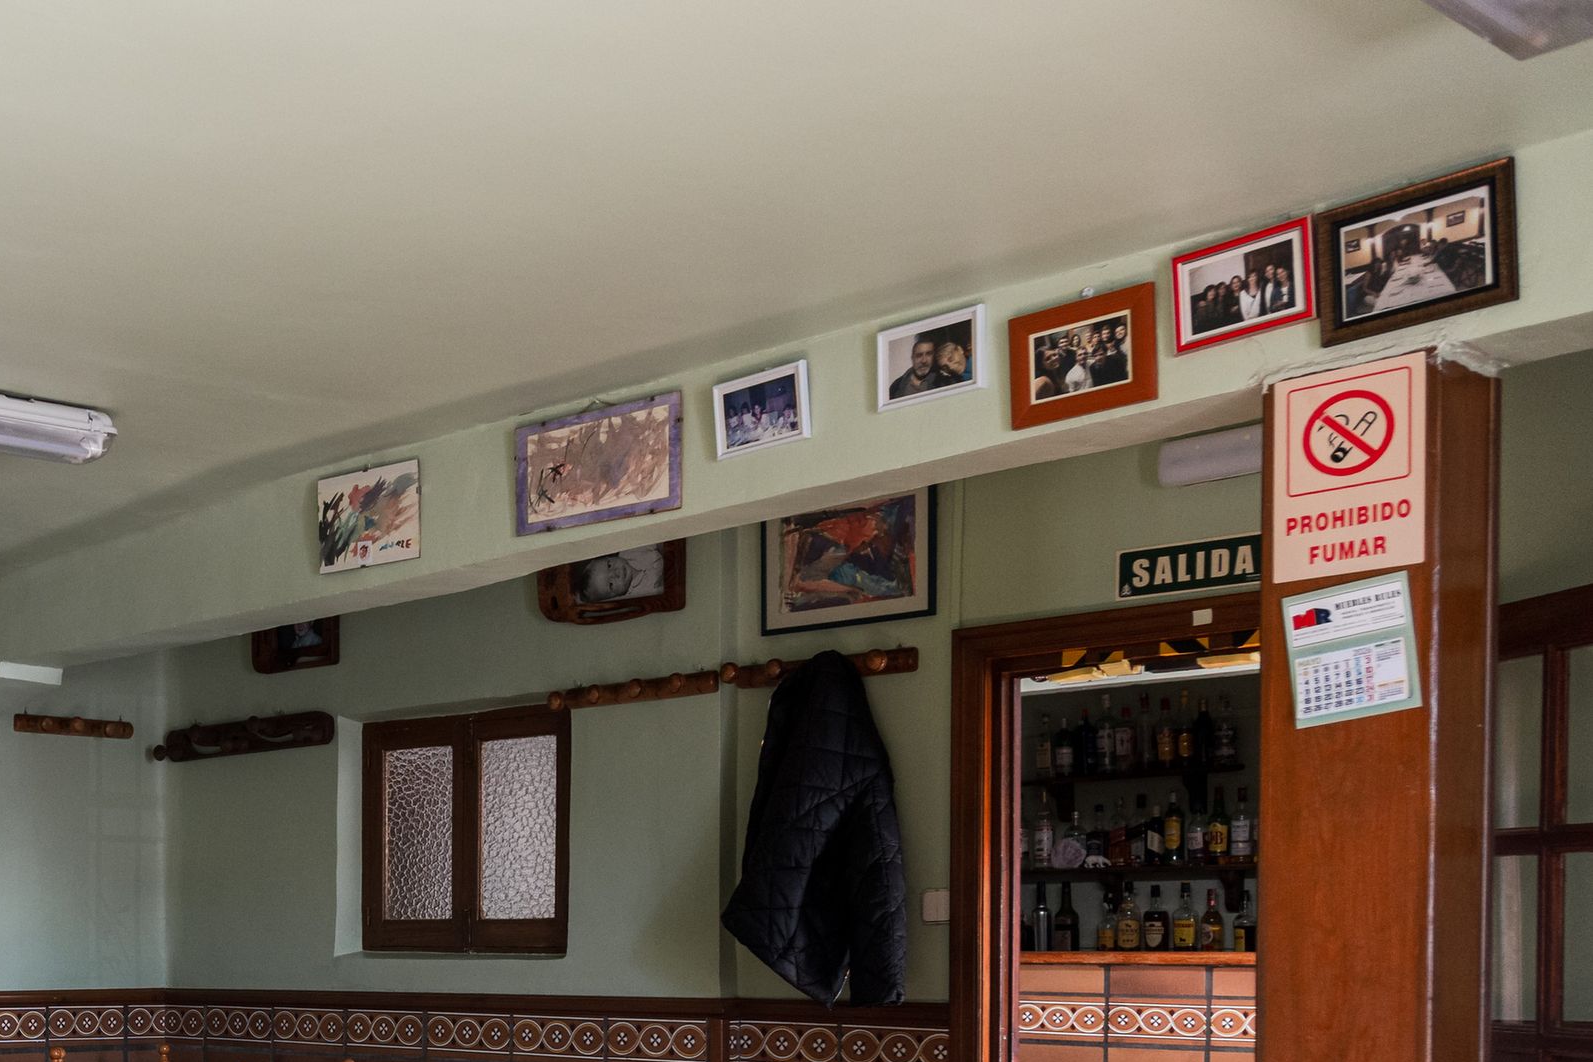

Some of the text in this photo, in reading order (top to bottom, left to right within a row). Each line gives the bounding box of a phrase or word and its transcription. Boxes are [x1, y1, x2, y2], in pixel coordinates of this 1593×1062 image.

[1286, 499, 1411, 535] PROHIBIDO
[1131, 544, 1256, 588] SALIDA
[1308, 535, 1387, 565] FUMAR
